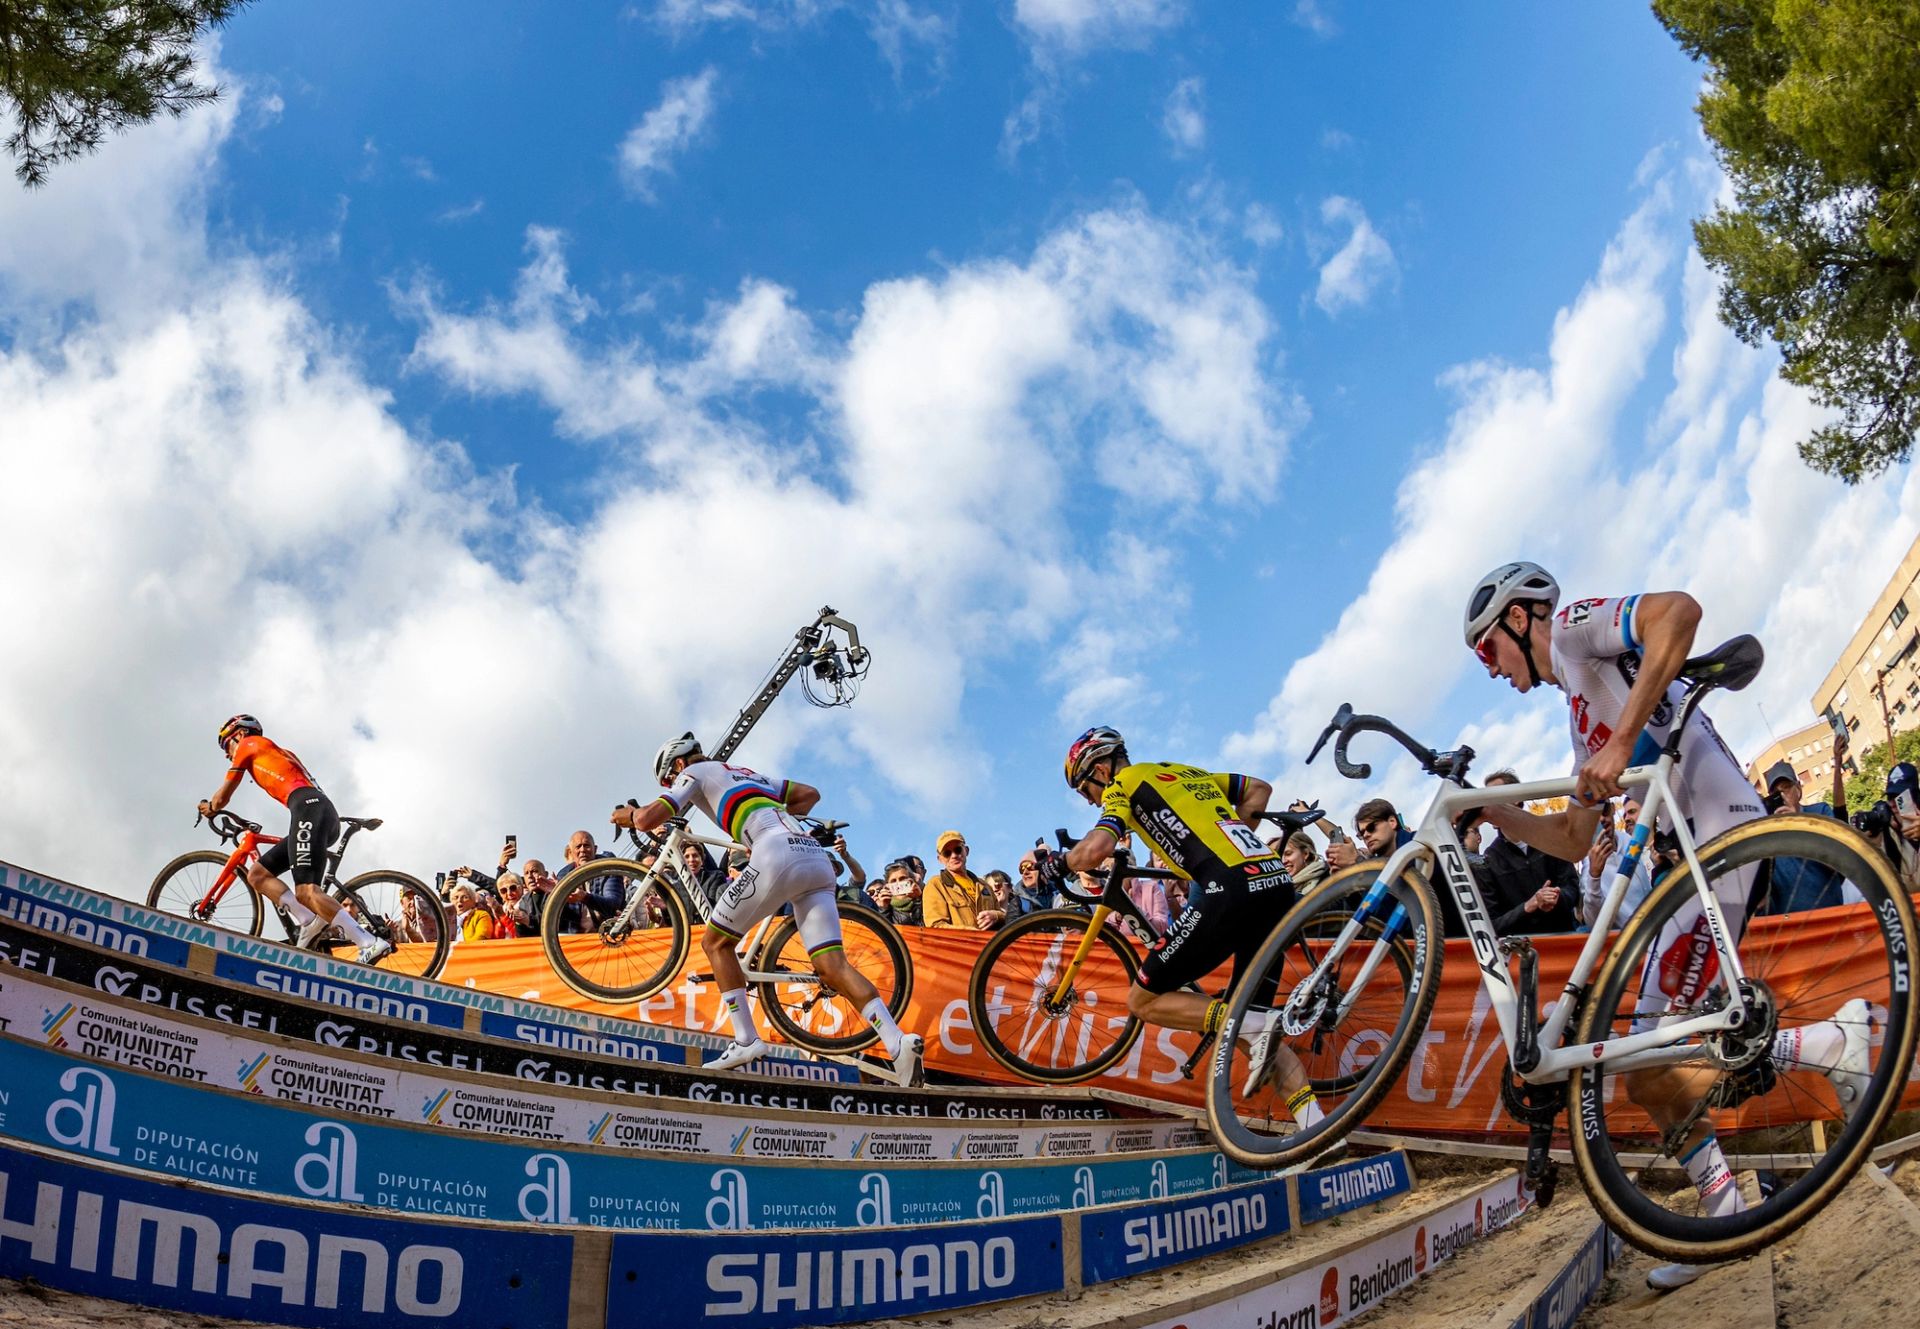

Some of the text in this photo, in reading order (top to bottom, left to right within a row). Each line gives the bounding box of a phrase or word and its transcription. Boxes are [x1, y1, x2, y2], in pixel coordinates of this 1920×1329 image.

[1570, 602, 1591, 624] 12
[1159, 808, 1191, 840] CAPS
[1231, 828, 1263, 849] 13
[296, 821, 313, 867] INEOS
[727, 869, 752, 902] Alpecin
[1437, 844, 1508, 986] RIDLEY
[1878, 898, 1907, 954] SWISS
[18, 873, 113, 918] WHIM
[123, 906, 216, 948] WHIM
[226, 936, 317, 973] WHIM
[327, 962, 414, 996] WHIM
[422, 984, 505, 1013] WHIM
[513, 1003, 589, 1027] WHIM
[596, 1017, 667, 1042] WHIM
[1158, 935, 1184, 963] lease
[1410, 924, 1426, 993] DT SWISS
[1674, 923, 1712, 1009] Pauwels
[1892, 959, 1909, 993] DT
[80, 1006, 199, 1046] Comunitat Valenciana
[1223, 1018, 1236, 1038] DT
[76, 1020, 196, 1065] COMUNITAT
[274, 1054, 386, 1086] Comunitat Valenciana
[1214, 1042, 1229, 1077] SWISS
[271, 1068, 384, 1104] COMUNITAT
[455, 1089, 556, 1114] Comunitat Valenciana
[452, 1102, 554, 1131] COMUNITAT
[616, 1112, 703, 1130] Comunitat Valenciana
[1581, 1089, 1600, 1140] SWISS
[136, 1126, 260, 1164] DIPUTACIÓN
[614, 1124, 702, 1146] COMUNITAT
[752, 1136, 827, 1154] COMUNITAT
[754, 1126, 828, 1138] Comunitat Valenciana
[869, 1142, 932, 1155] COMUNITAT
[134, 1147, 258, 1185] DE ALICANTE
[378, 1172, 487, 1198] DIPUTACIÓN
[1013, 1194, 1061, 1207] DIPUTACIÓN
[1320, 1160, 1396, 1209] SHIMANO
[377, 1192, 487, 1217] DE ALICANTE
[589, 1196, 680, 1213] DIPUTACIÓN
[763, 1202, 837, 1216] DIPUTACIÓN
[902, 1200, 962, 1213] DIPUTACIÓN
[589, 1214, 681, 1229] DE ALICANTE
[1123, 1193, 1267, 1264] SHIMANO
[1432, 1222, 1474, 1264] Benidorm
[704, 1236, 1016, 1316] SHIMANO
[1349, 1253, 1413, 1312] Benidorm
